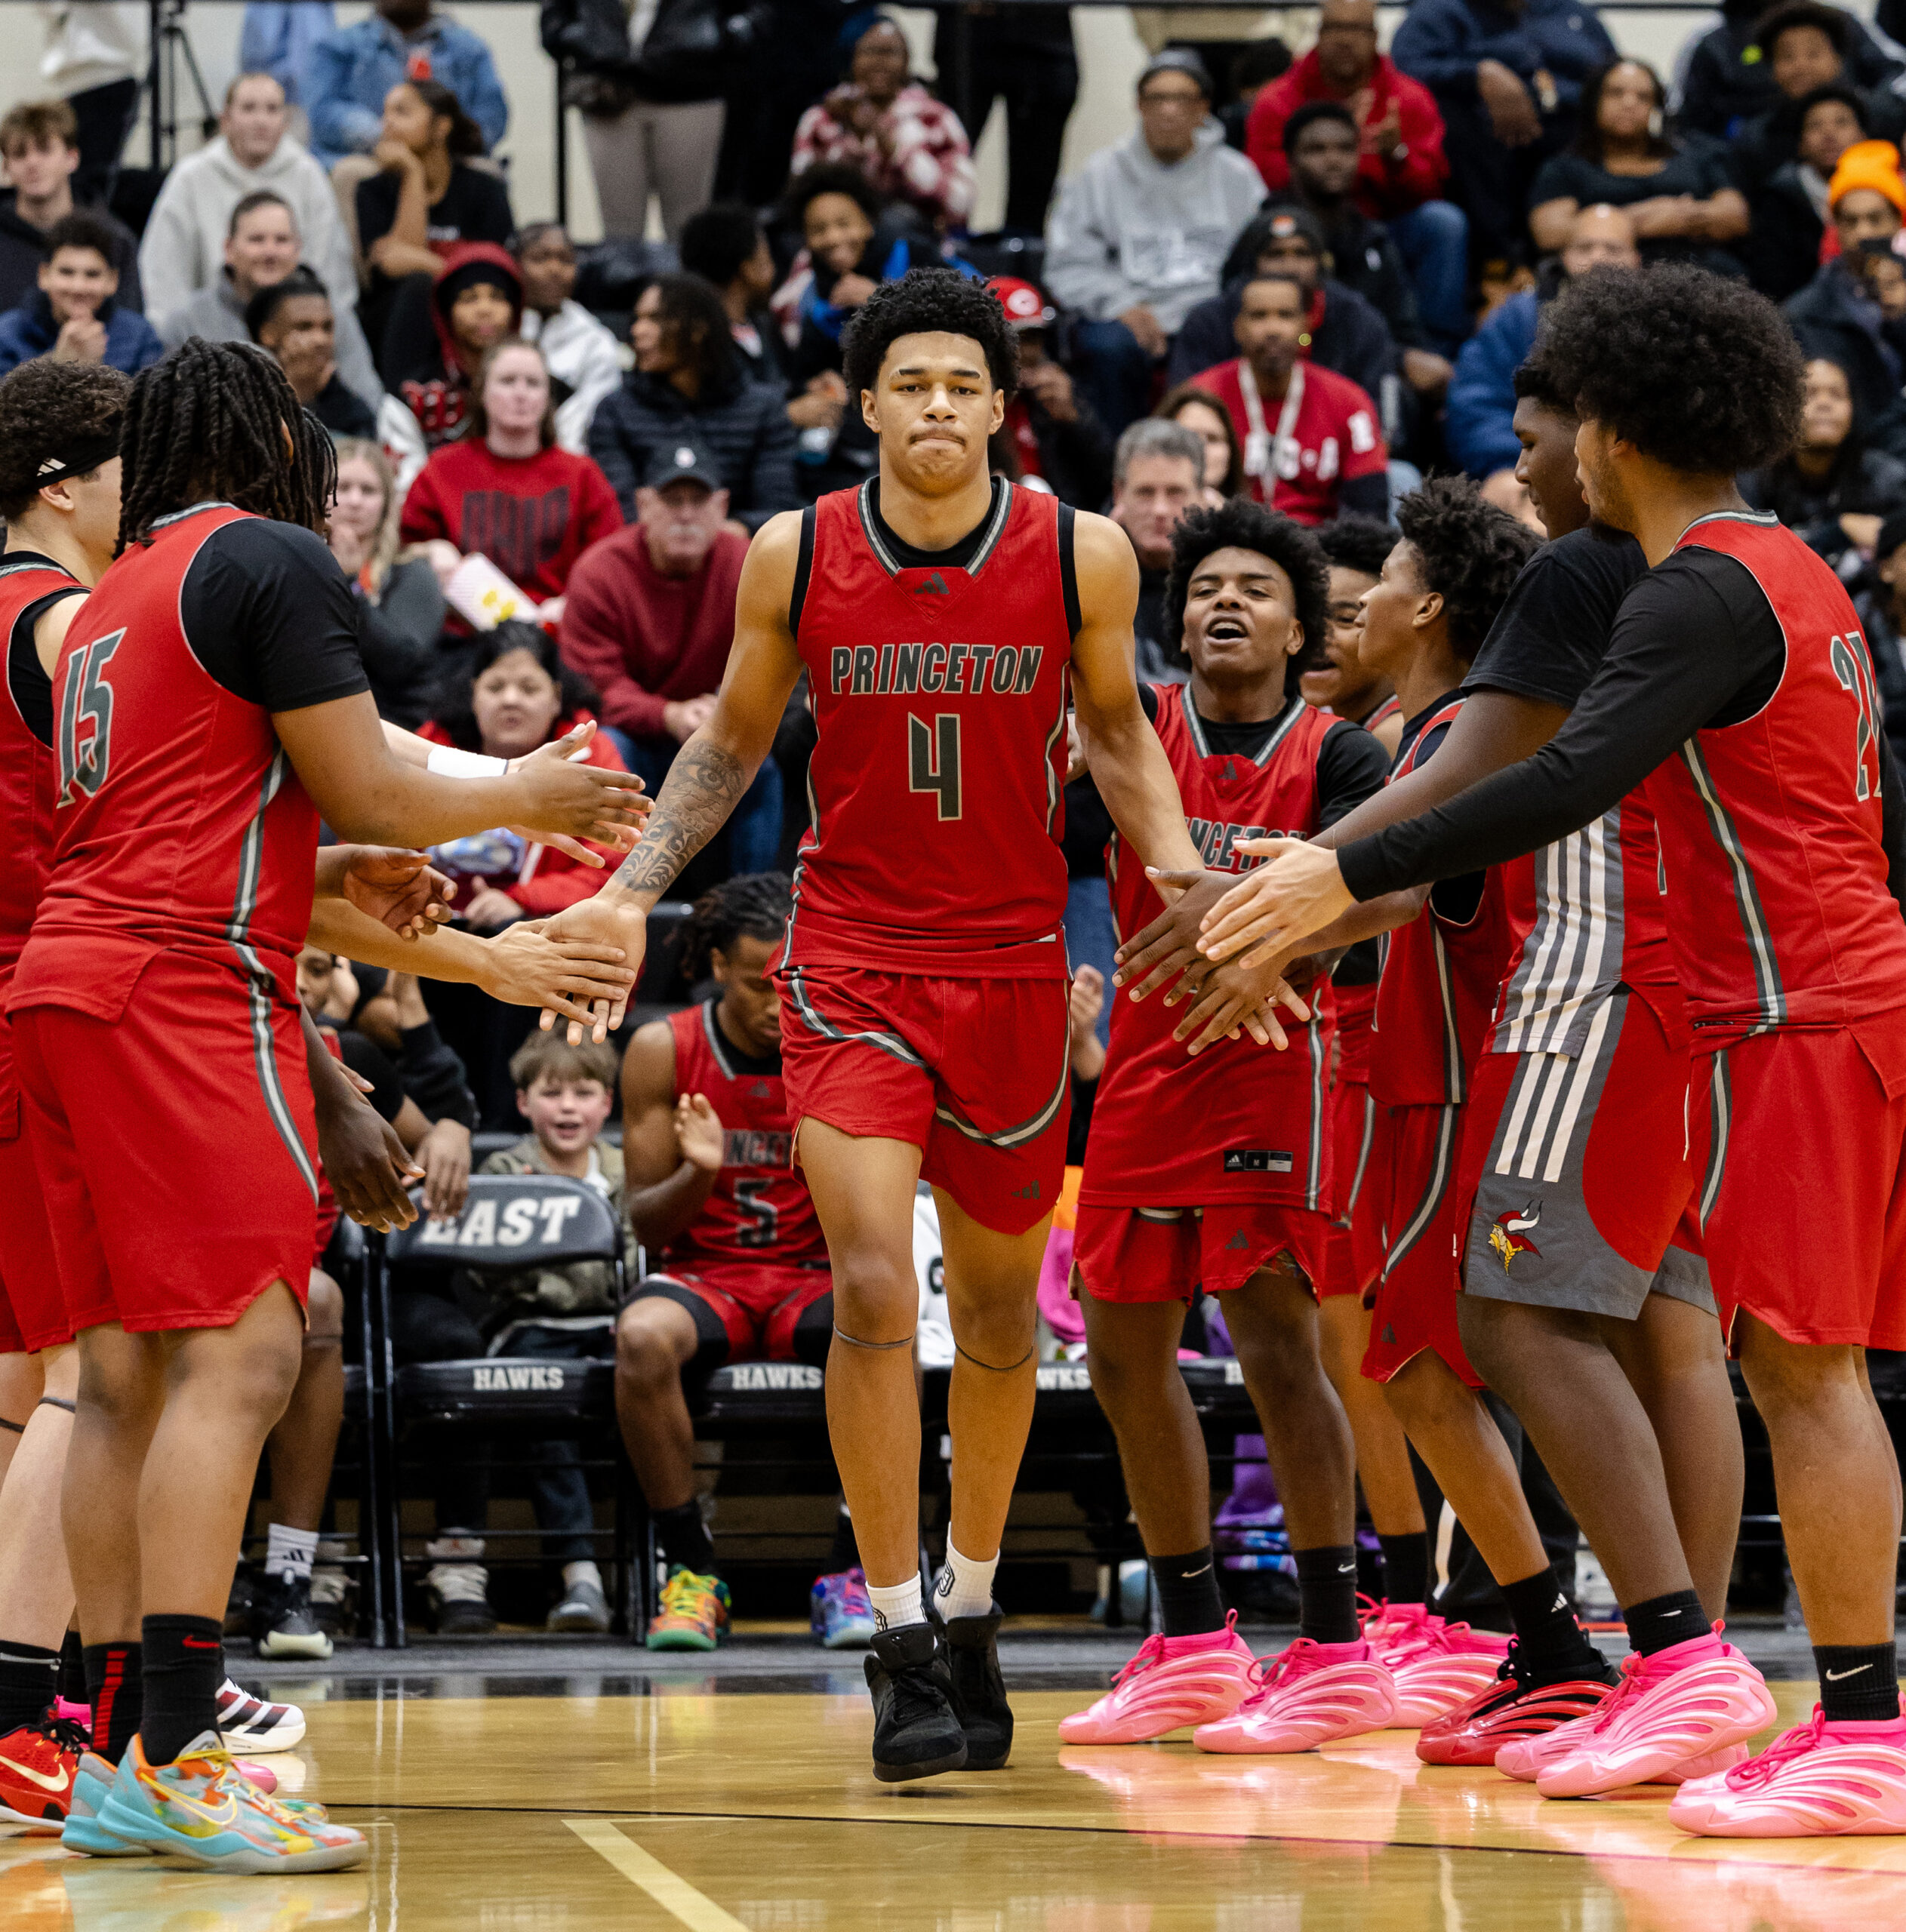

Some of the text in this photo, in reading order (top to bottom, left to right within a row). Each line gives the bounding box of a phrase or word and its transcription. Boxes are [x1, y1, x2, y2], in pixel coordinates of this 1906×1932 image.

[831, 642, 1044, 695] PRINCETON
[56, 626, 128, 809] 15
[907, 711, 962, 822] 4
[733, 1177, 778, 1247] 5
[473, 1366, 565, 1390] HAWKS
[732, 1366, 823, 1390] HAWKS
